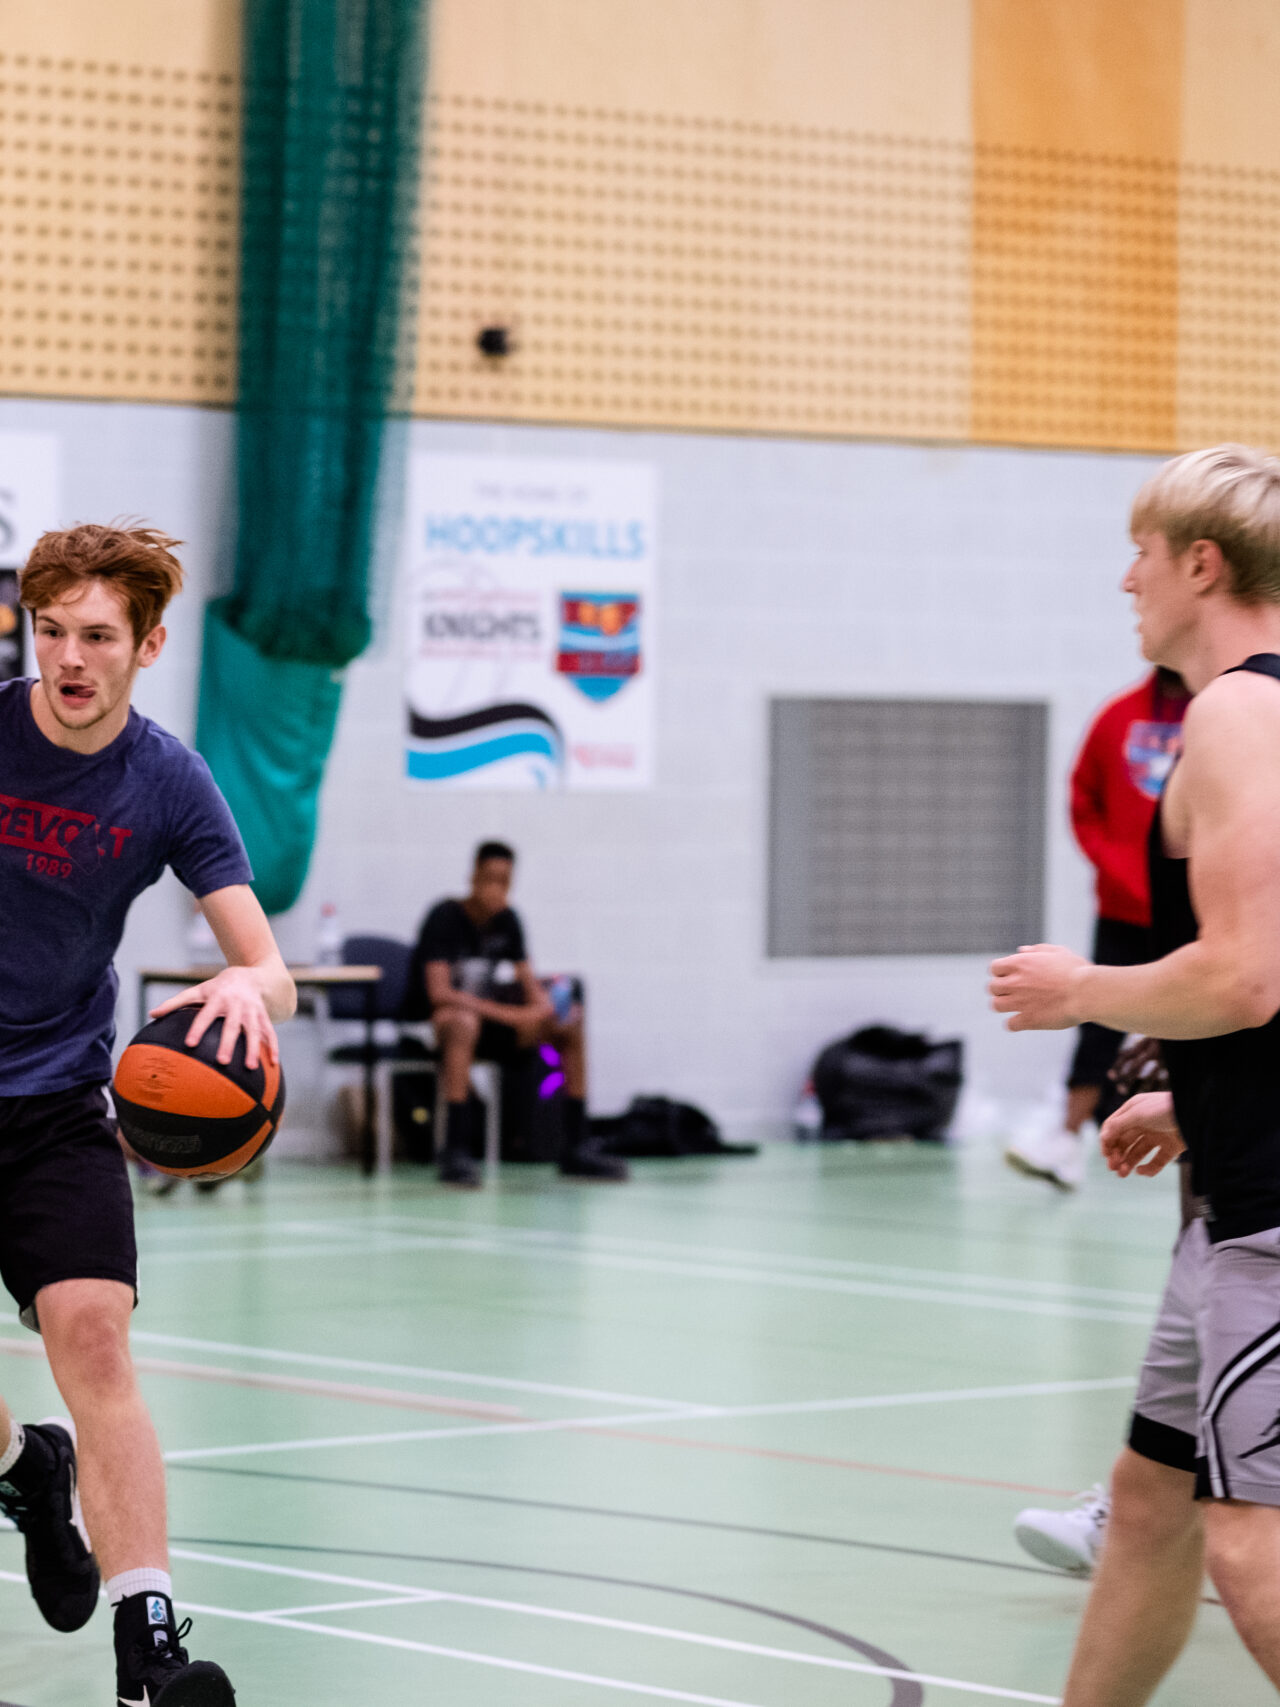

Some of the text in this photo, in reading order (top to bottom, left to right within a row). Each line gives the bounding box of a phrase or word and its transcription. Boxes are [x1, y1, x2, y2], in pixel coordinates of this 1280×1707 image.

[426, 514, 644, 558] HOOPSKILLS
[424, 611, 541, 641] KNIGHTS
[26, 852, 72, 878] 1989
